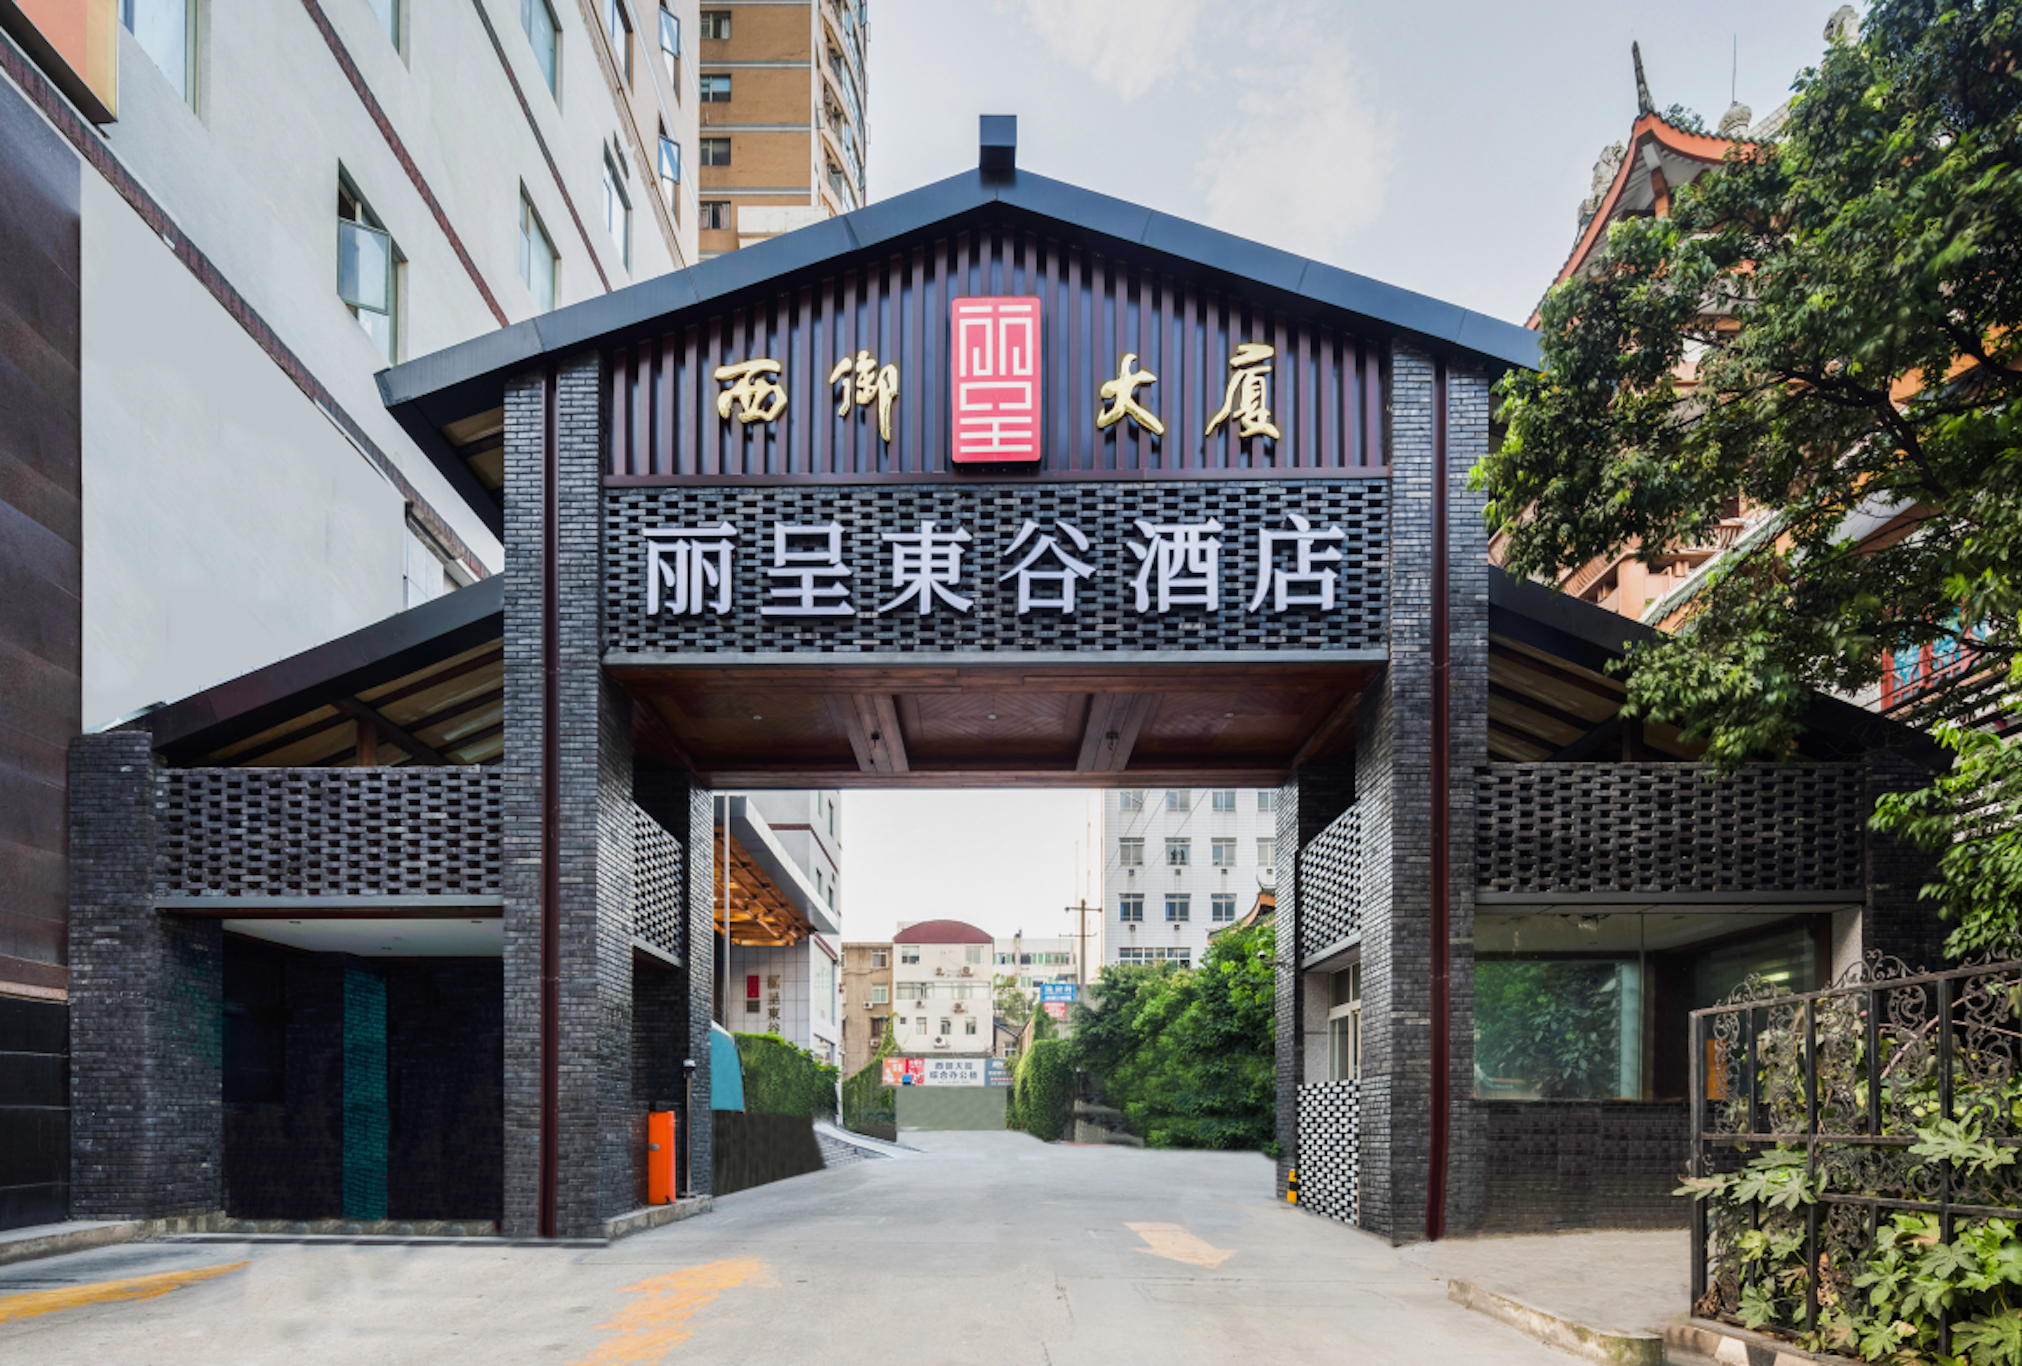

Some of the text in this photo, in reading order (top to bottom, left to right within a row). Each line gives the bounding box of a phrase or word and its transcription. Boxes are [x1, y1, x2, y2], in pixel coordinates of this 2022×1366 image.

[958, 304, 1033, 454] 丽呈
[641, 511, 1346, 618] 丽呈東谷酒店
